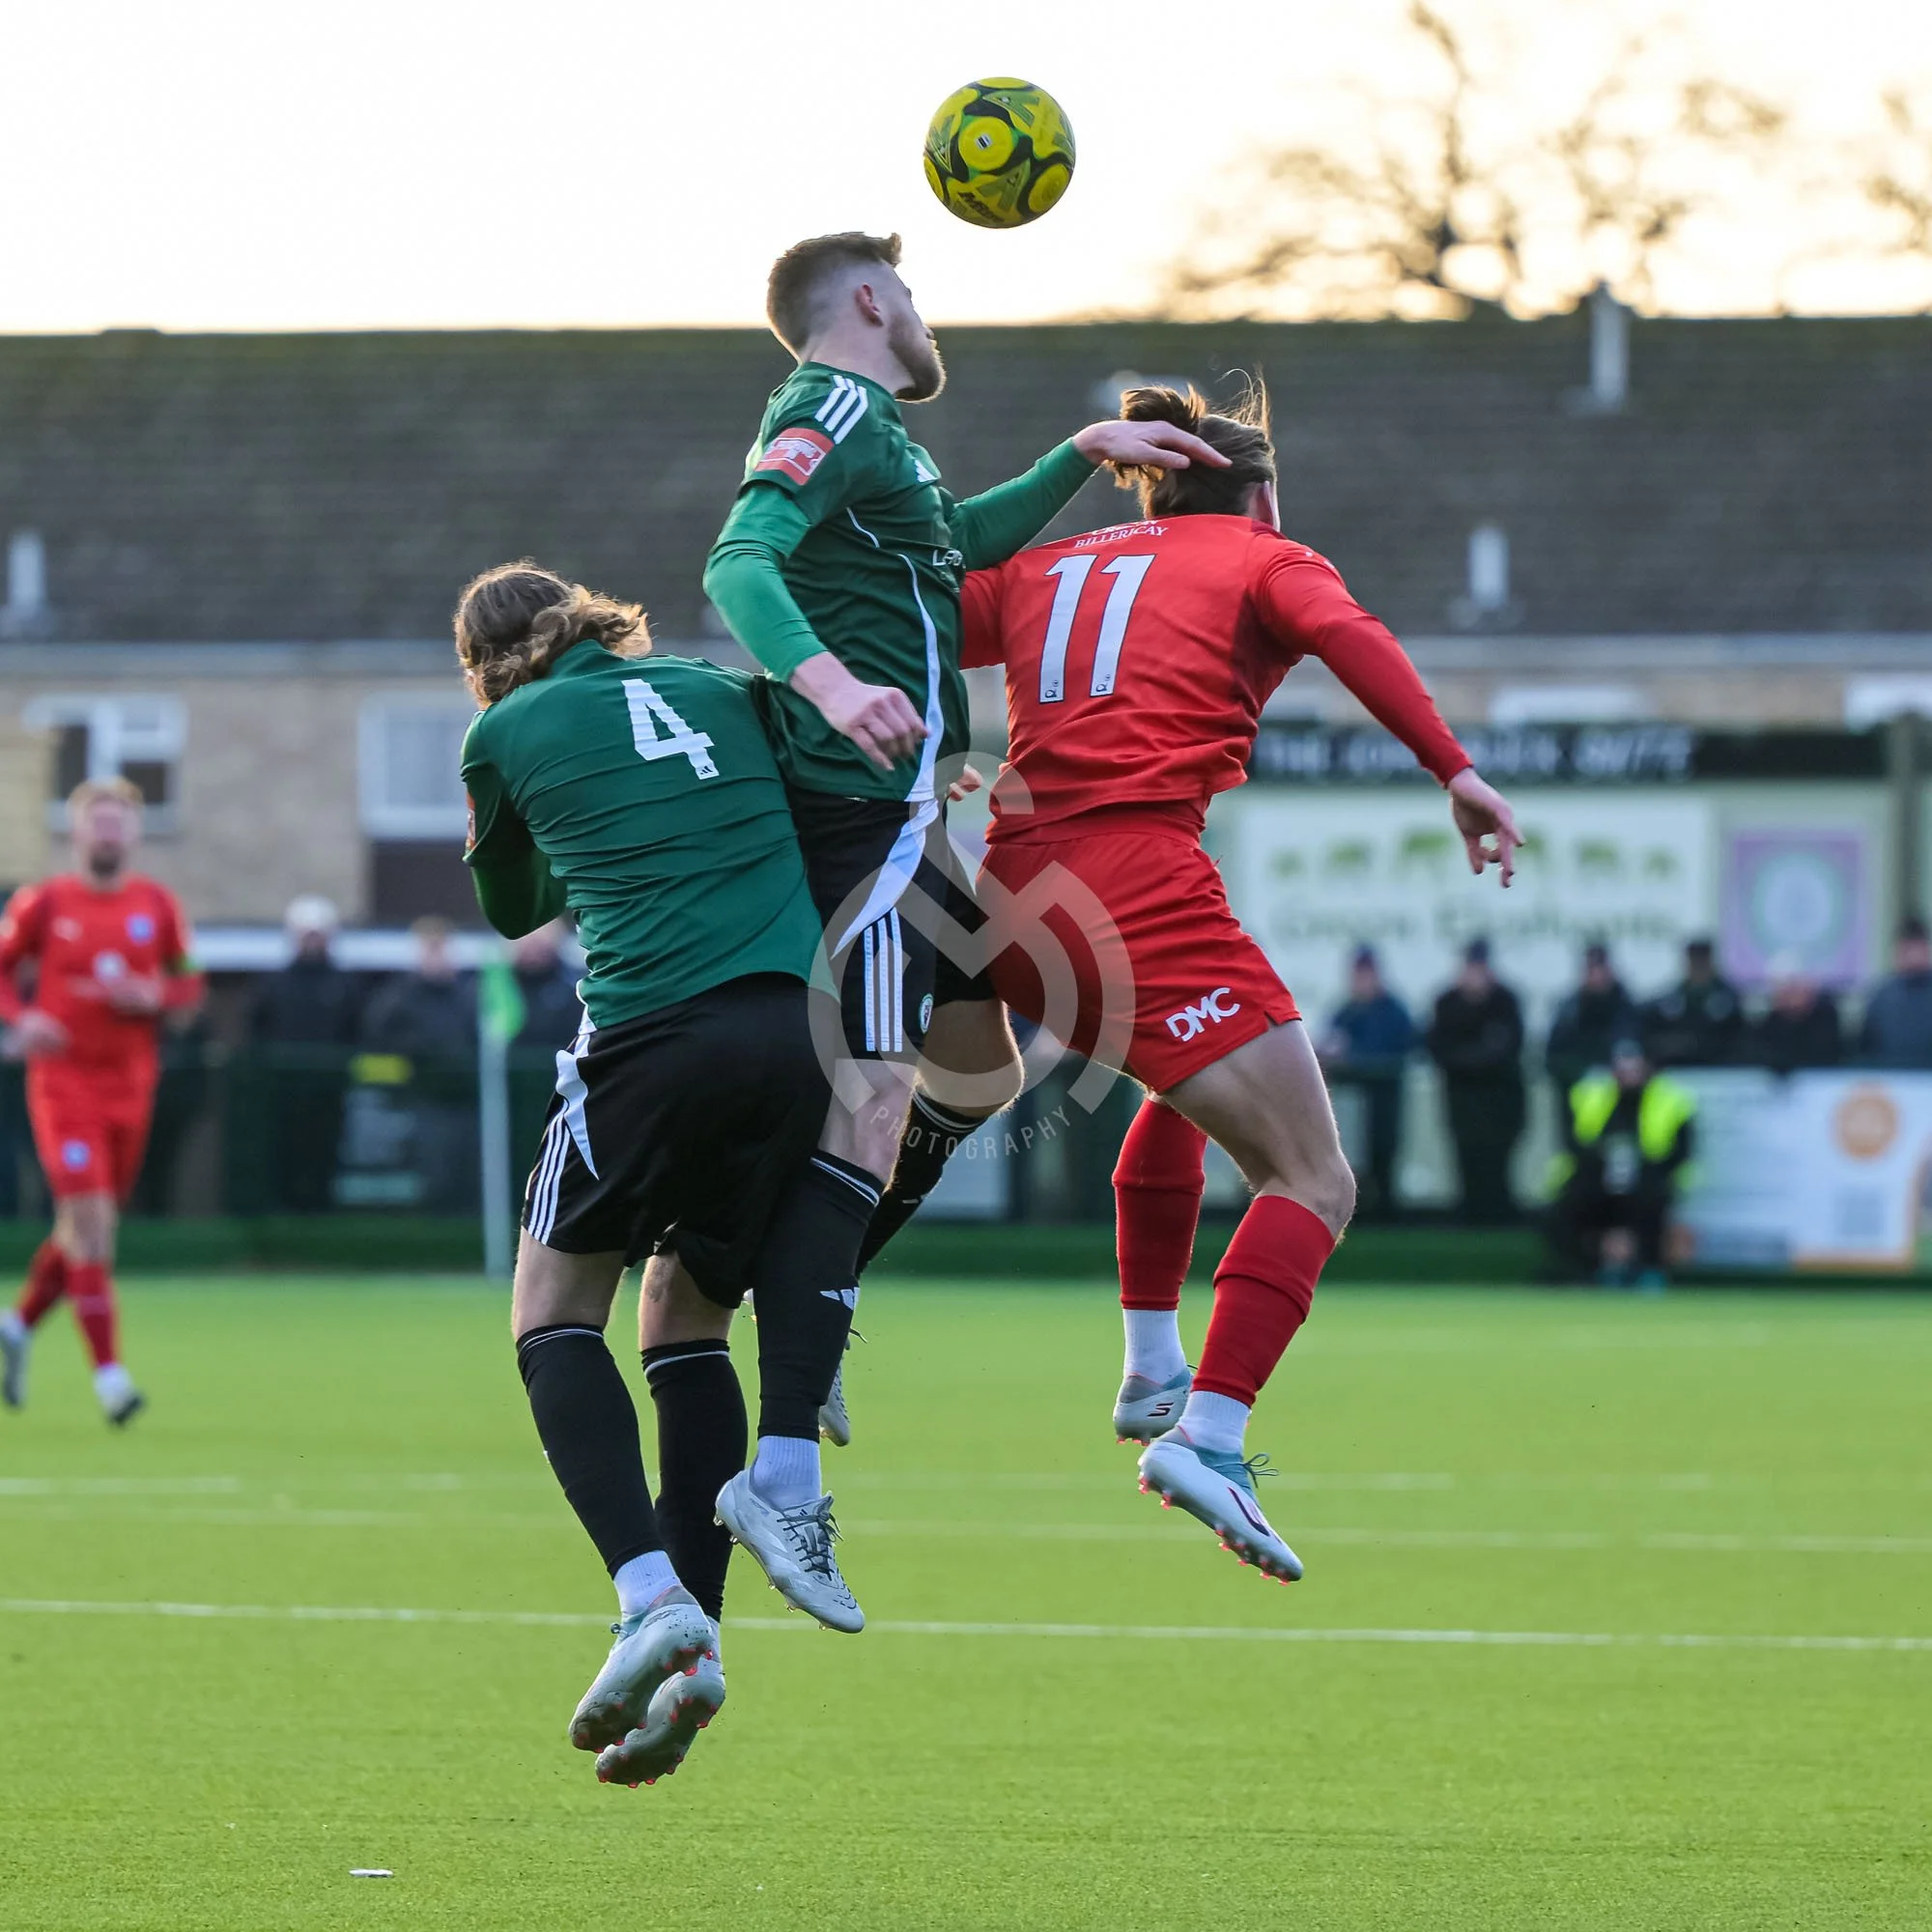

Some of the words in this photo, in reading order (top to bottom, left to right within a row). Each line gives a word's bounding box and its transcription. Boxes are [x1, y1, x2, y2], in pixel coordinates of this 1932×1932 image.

[1074, 526, 1169, 549] BILLERICAY
[1038, 554, 1156, 704] 11
[621, 678, 720, 780] 4
[1165, 986, 1240, 1042] DMC
